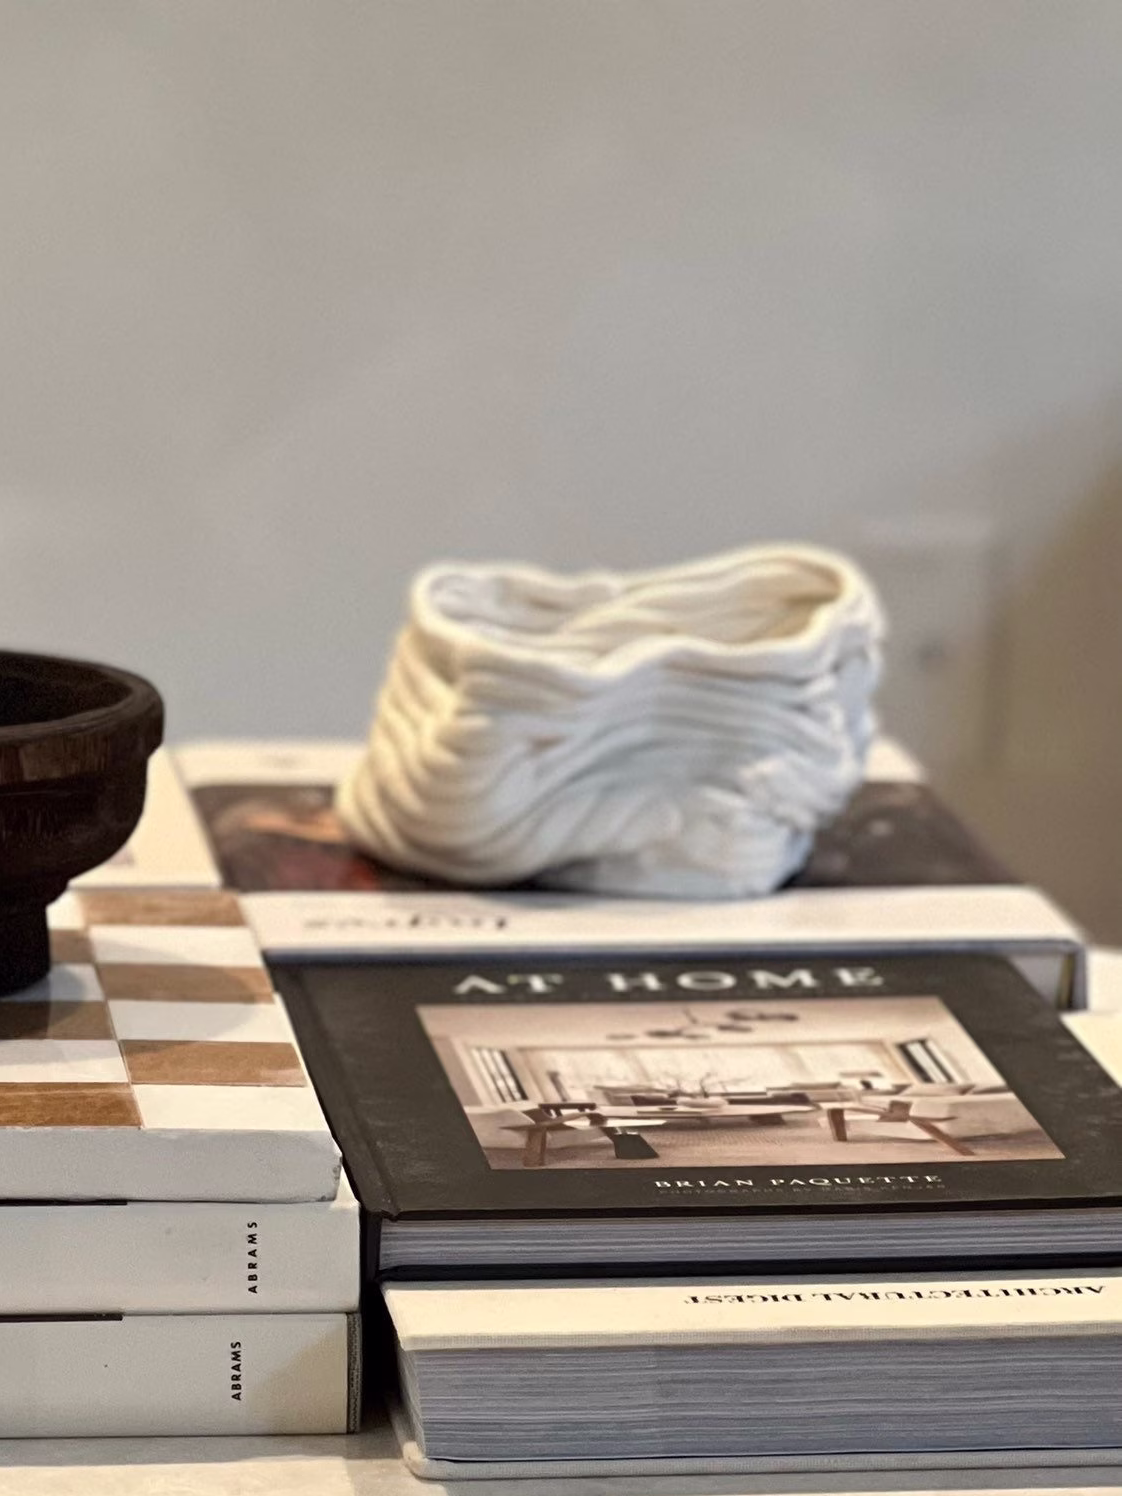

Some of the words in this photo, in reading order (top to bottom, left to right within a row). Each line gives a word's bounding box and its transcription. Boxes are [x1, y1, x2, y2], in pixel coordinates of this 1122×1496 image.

[452, 972, 565, 994] AT
[605, 966, 885, 992] HOME
[654, 1179, 755, 1189] BRIAN
[770, 1174, 943, 1187] PAQUETTE
[247, 1221, 258, 1294] ABRAMS
[682, 1290, 803, 1305] DIGEST
[813, 1284, 1106, 1302] ARCHITECTURAL
[230, 1341, 242, 1401] ABRAMS
